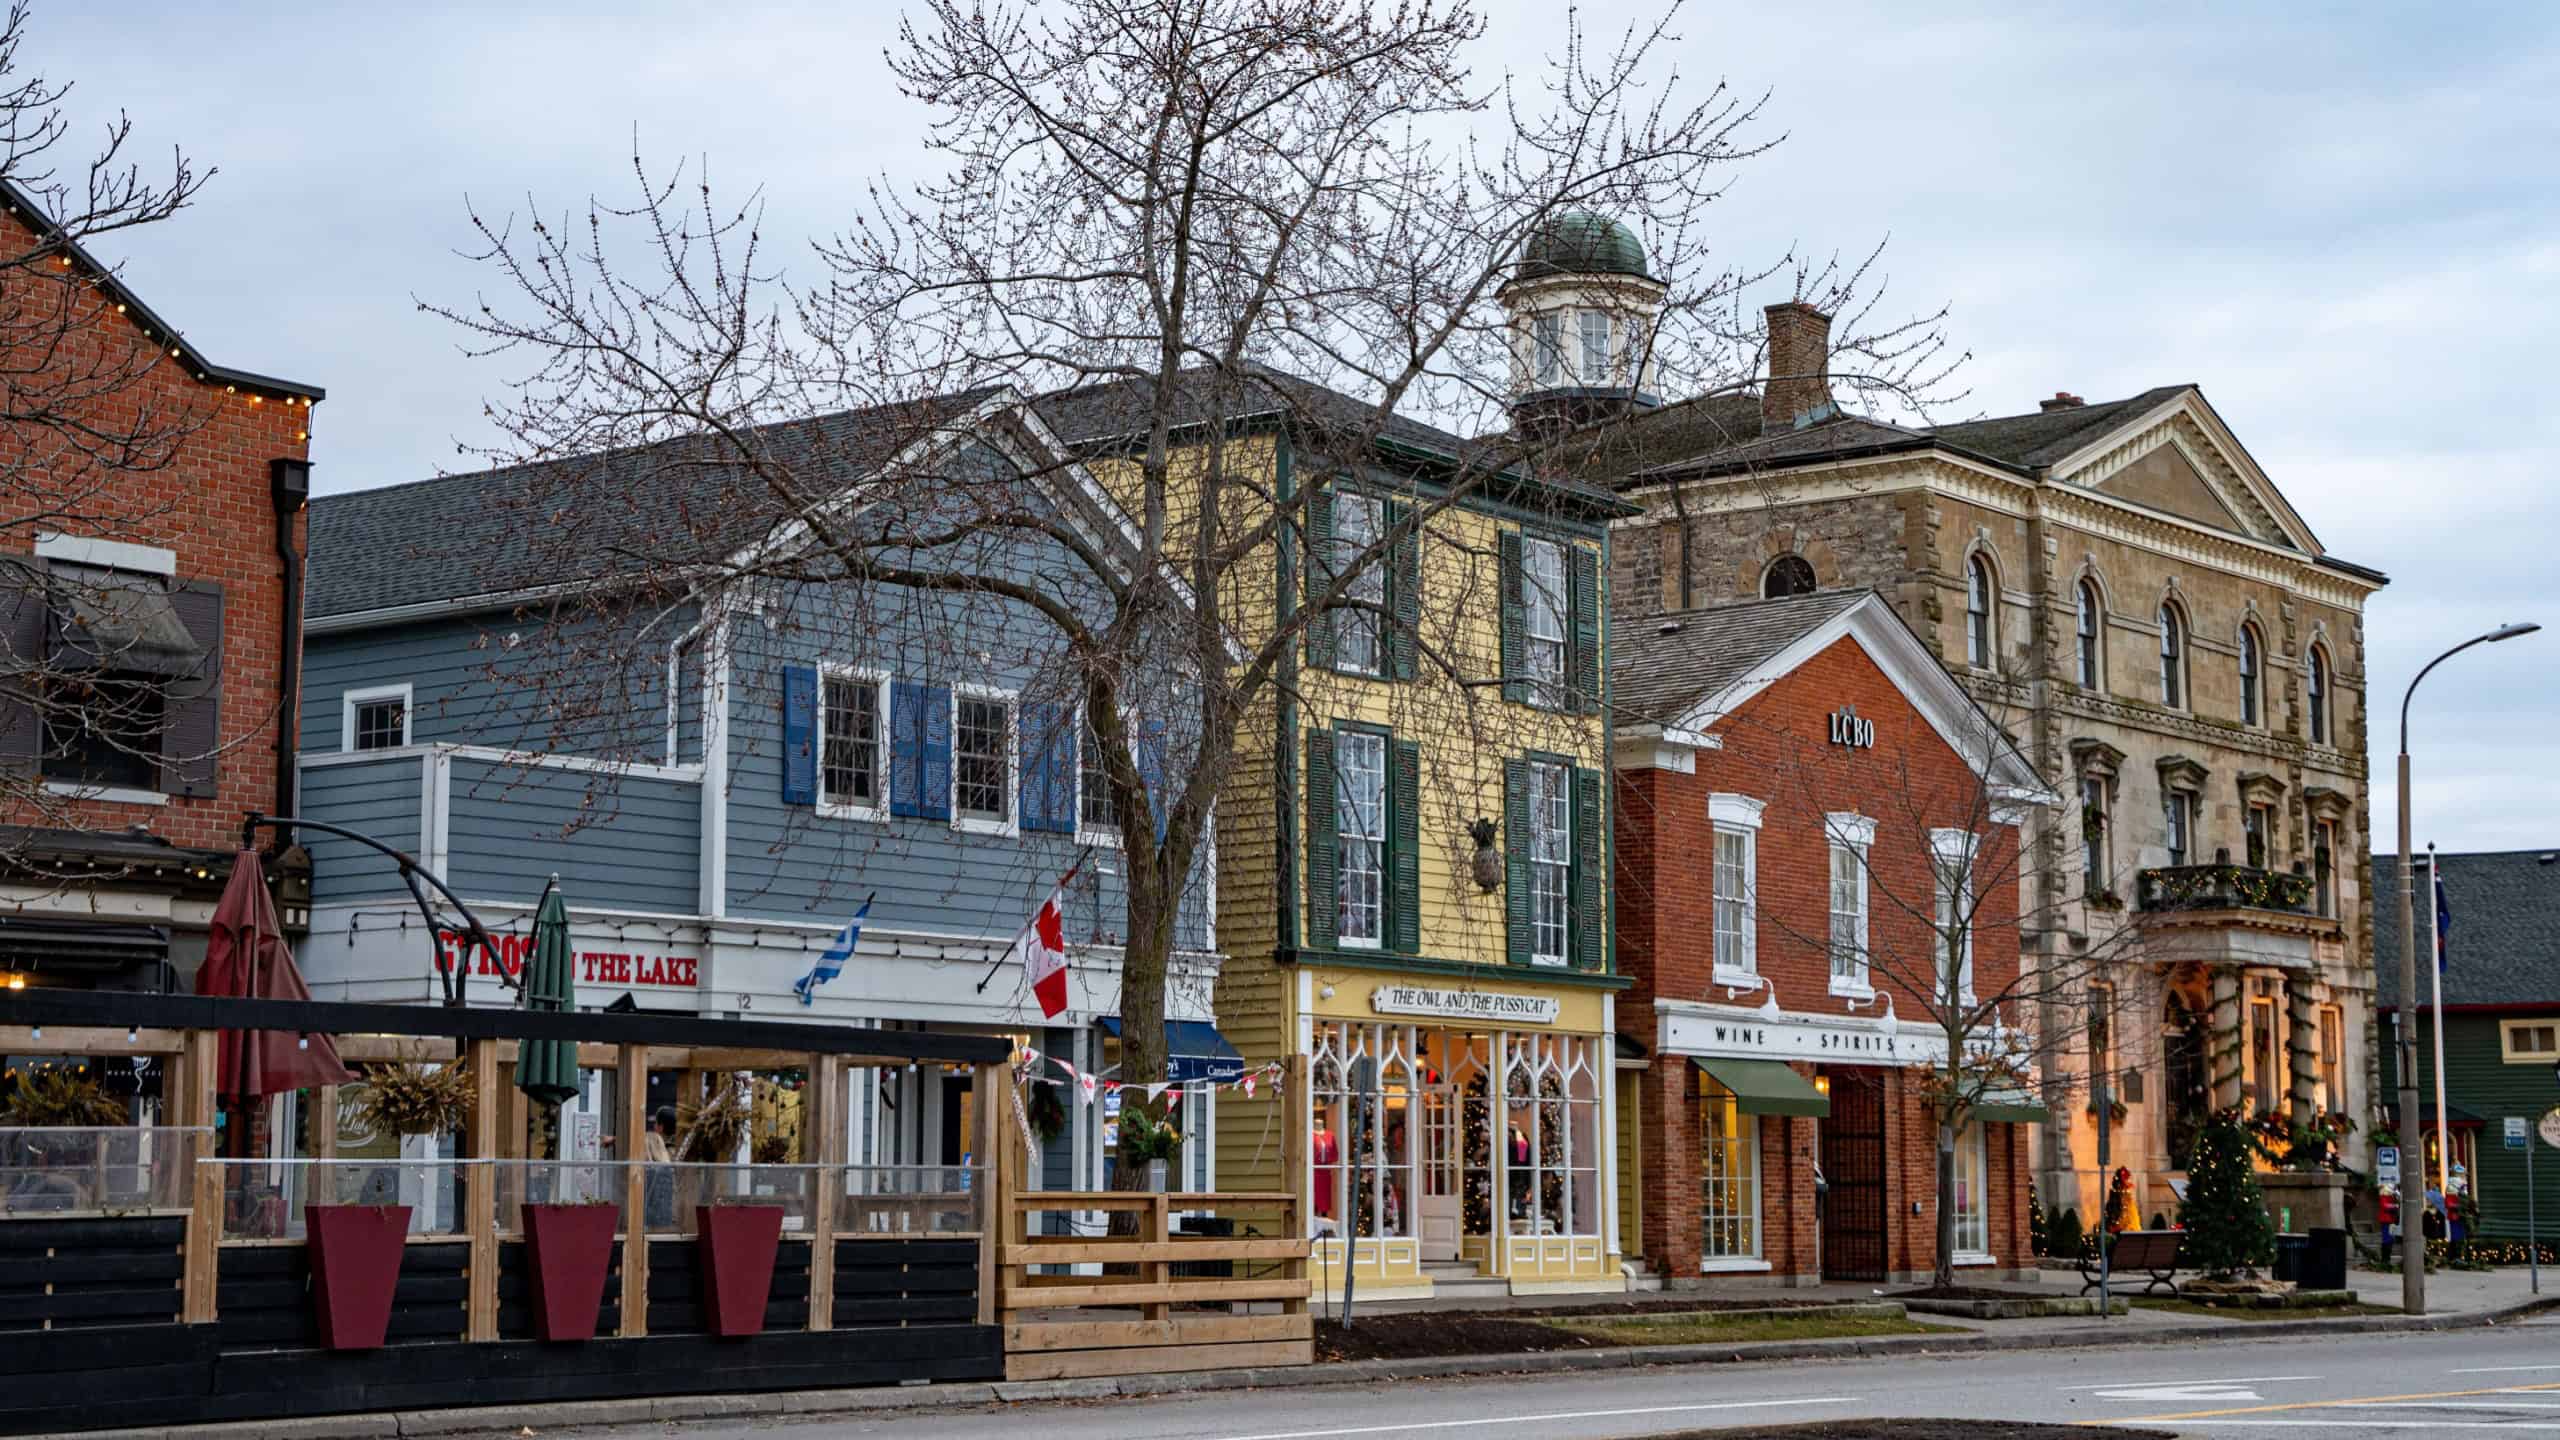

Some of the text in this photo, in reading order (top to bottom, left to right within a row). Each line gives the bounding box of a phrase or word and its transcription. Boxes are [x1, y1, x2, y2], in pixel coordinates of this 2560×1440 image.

[1829, 712, 1874, 749] LCBO
[583, 953, 630, 982] THE
[636, 956, 697, 986] LAKE
[736, 993, 751, 1009] 12
[1392, 990, 1415, 1005] THE
[1417, 991, 1441, 1007] OWL
[1444, 992, 1467, 1008] AND
[1470, 994, 1491, 1010] THE
[1494, 996, 1546, 1013] PUSSYCAT
[1716, 1026, 1895, 1051] WINE SPIRITS
